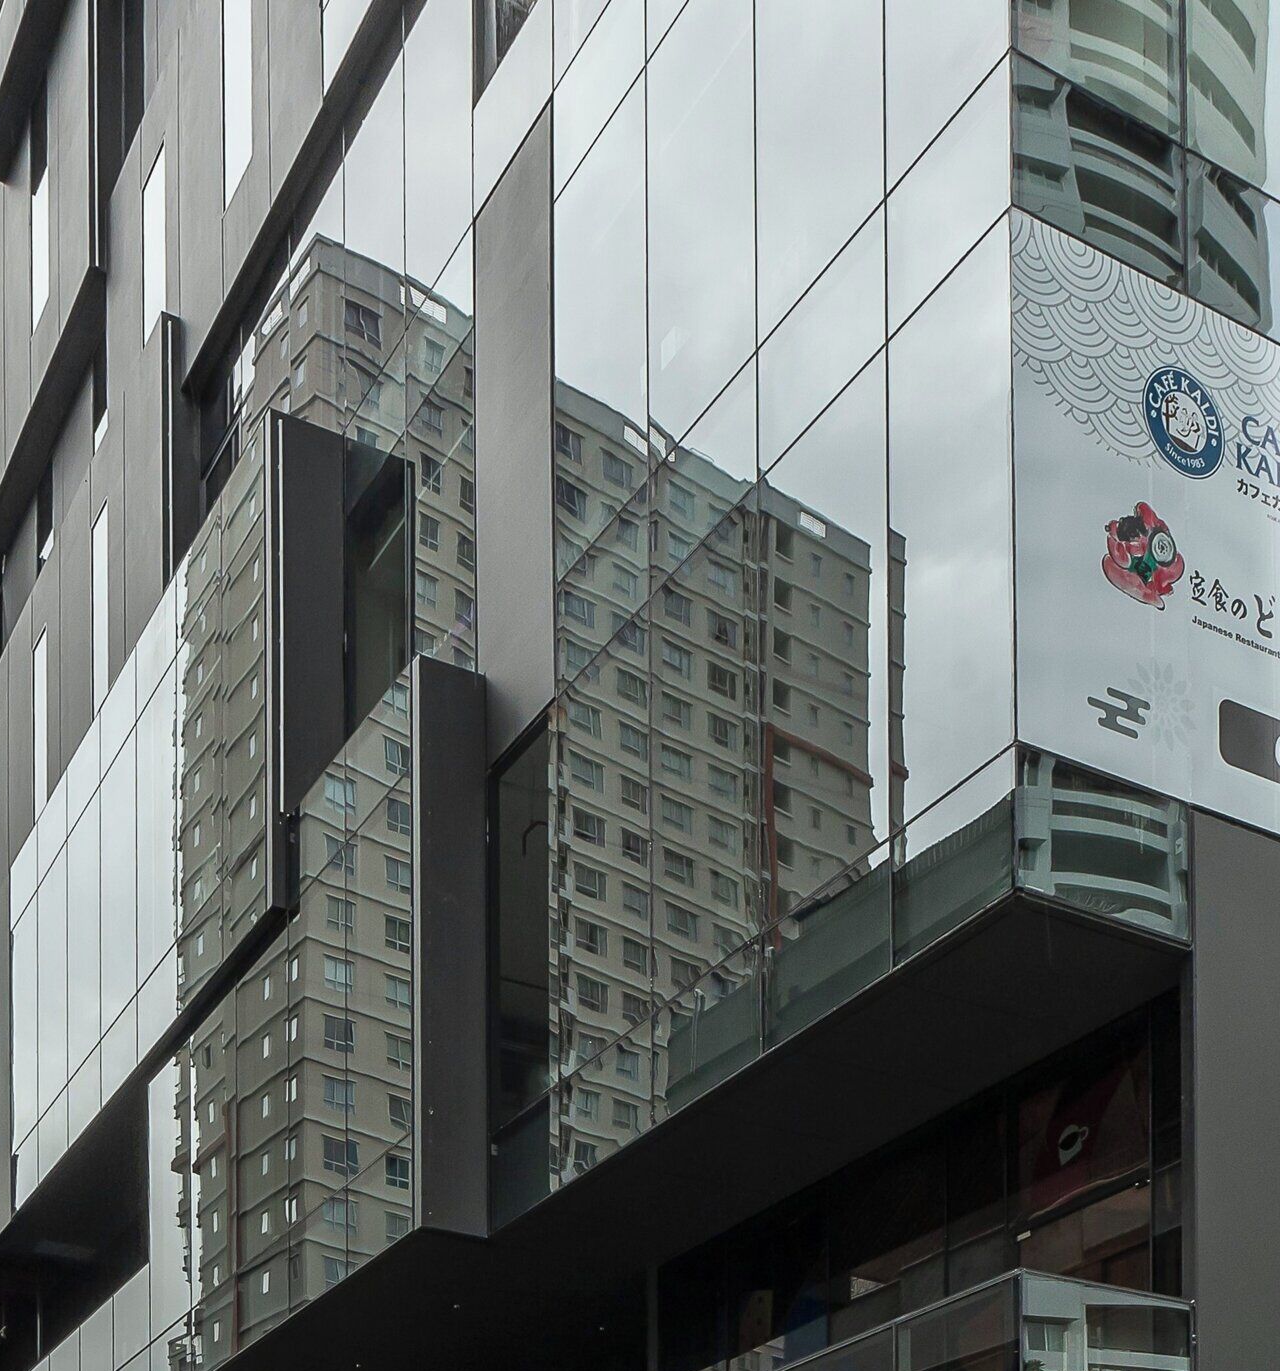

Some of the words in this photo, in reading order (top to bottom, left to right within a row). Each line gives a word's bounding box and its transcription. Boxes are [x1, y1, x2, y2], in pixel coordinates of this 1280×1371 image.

[1149, 371, 1178, 409] CAFÉ
[1181, 377, 1219, 442] KALDI
[1192, 615, 1233, 639] Japanese
[1235, 633, 1280, 659] Restaurant
